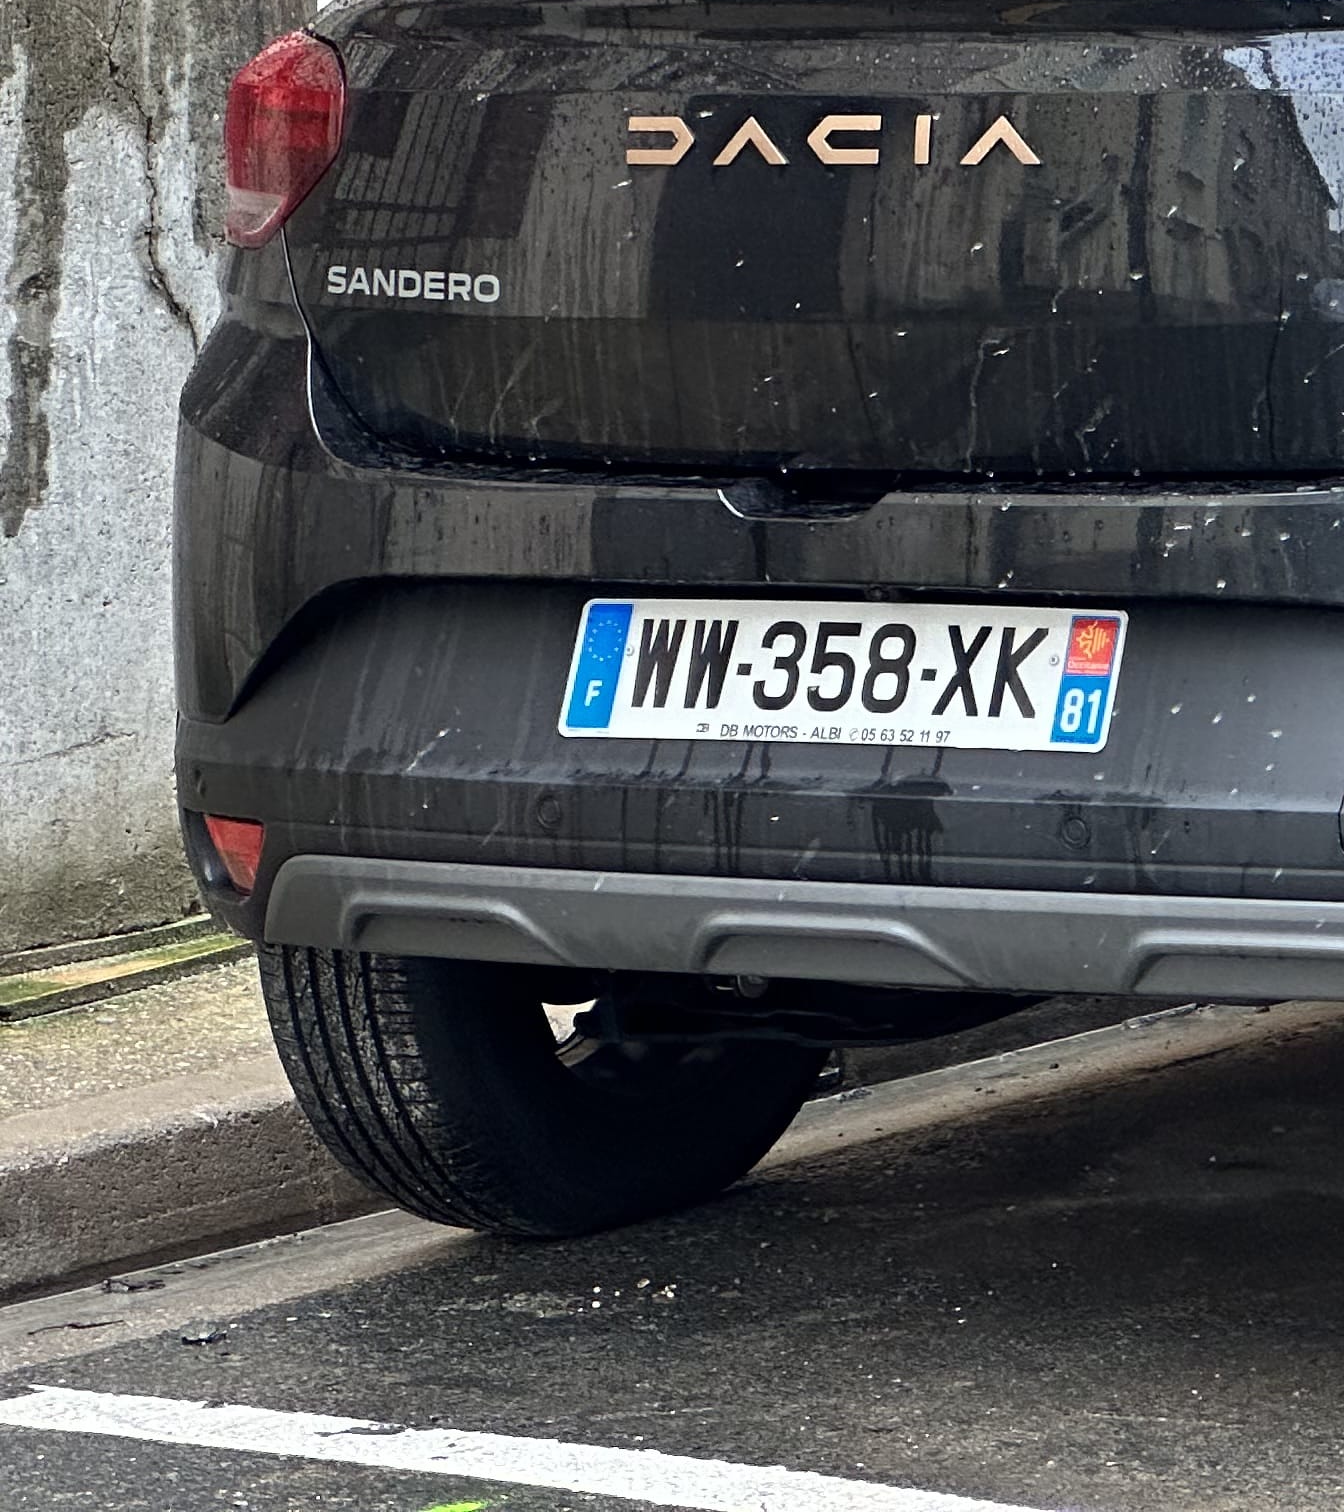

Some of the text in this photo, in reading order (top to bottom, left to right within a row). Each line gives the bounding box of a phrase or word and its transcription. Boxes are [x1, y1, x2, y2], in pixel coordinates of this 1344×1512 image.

[626, 113, 1042, 166] DACIA
[326, 265, 502, 304] SANDERO
[630, 618, 1050, 719] WW-358-XK
[583, 679, 604, 708] F
[1059, 687, 1103, 735] 81
[720, 723, 739, 738] DB
[742, 724, 799, 740] MOTORS
[809, 726, 842, 740] ALBI
[860, 728, 876, 742] 05
[880, 729, 895, 743] 63
[899, 729, 915, 743] 52
[919, 730, 931, 744] 11
[935, 730, 952, 744] 97
